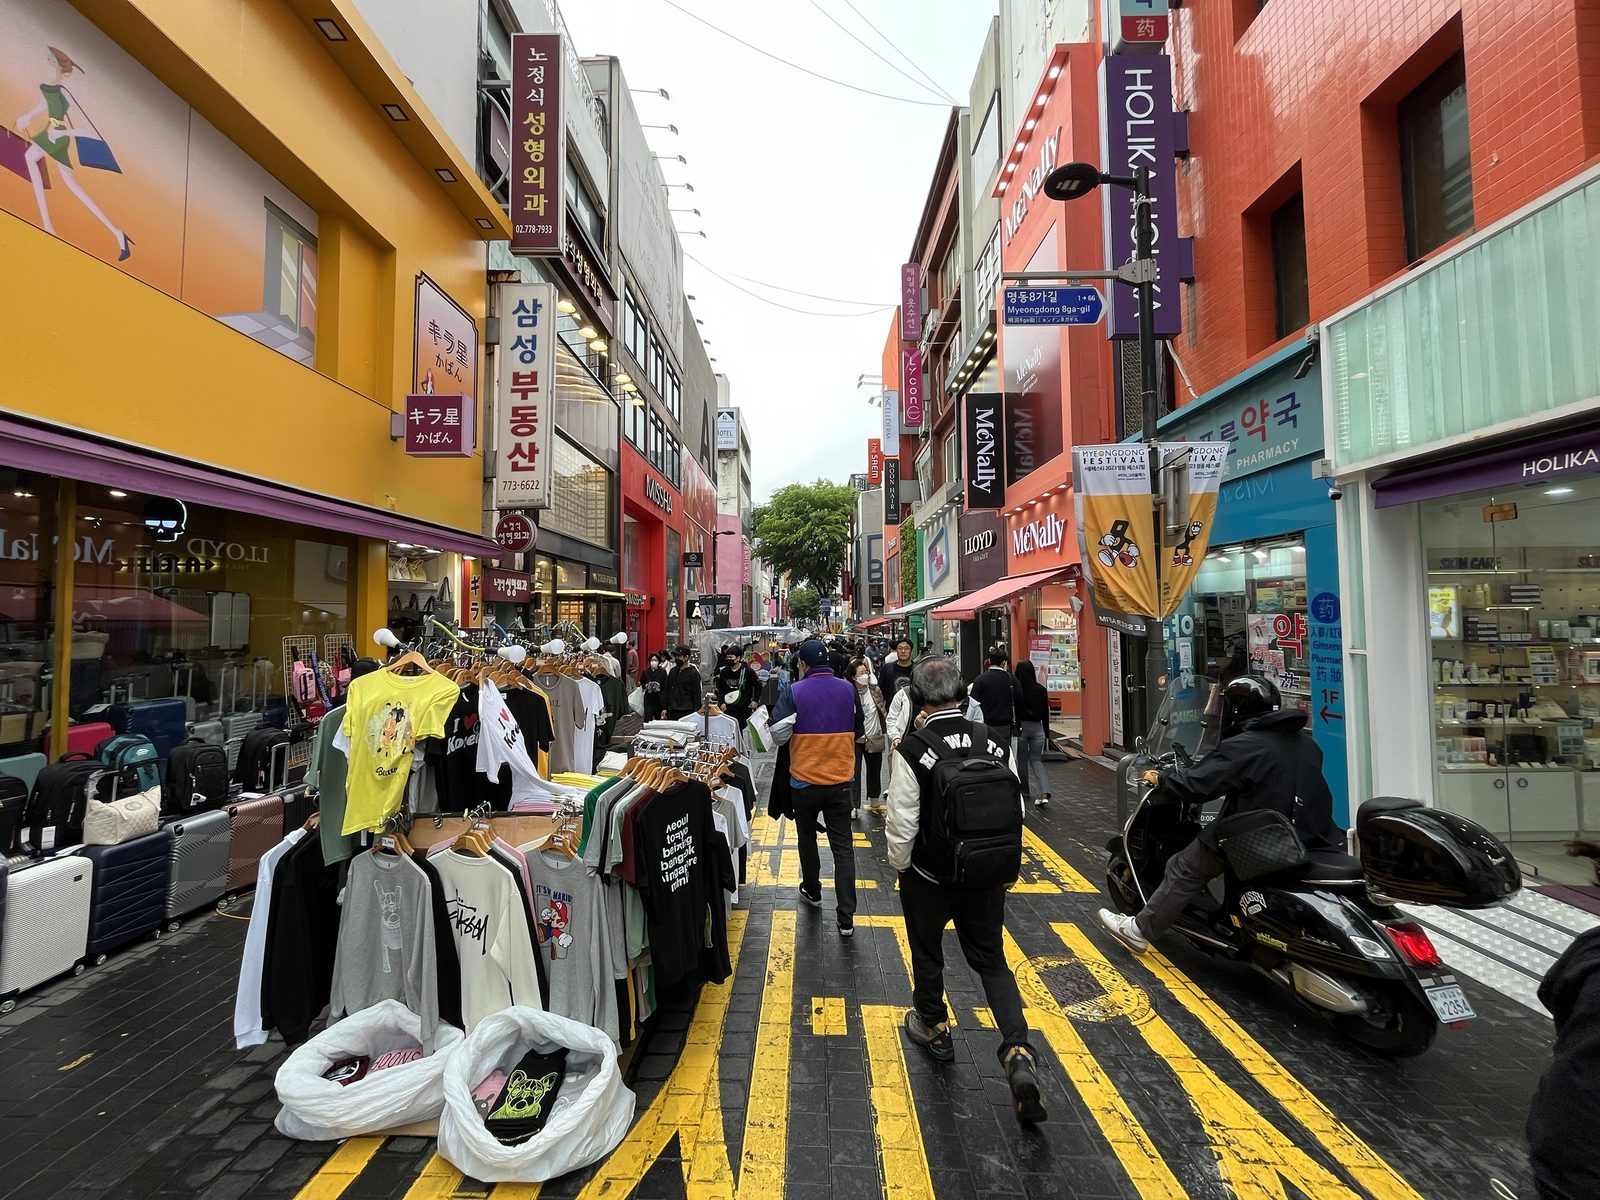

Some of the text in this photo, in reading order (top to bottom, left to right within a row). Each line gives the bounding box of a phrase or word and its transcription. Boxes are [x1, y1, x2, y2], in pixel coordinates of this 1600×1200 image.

[1136, 19, 1155, 37] 药
[522, 47, 549, 217] 노정식 성형외과
[515, 224, 553, 234] 02.778-7933
[1007, 291, 1058, 304] 명동8가길
[1007, 304, 1091, 315] Myeongdong 8ga-gil
[429, 318, 469, 369] キラ星
[435, 353, 463, 383] かばん
[409, 407, 461, 426] キラ星
[415, 432, 453, 444] かばん
[1082, 448, 1145, 457] MYEONGDONG
[1083, 456, 1145, 465] FESTIVAL
[1237, 437, 1300, 470] PHARMACY
[1522, 448, 1600, 477] HOLIKA
[502, 480, 540, 491] 773-6622
[646, 473, 673, 516] MISSHA
[964, 529, 994, 556] LLOYD
[1440, 556, 1468, 570] SKIN
[1272, 612, 1307, 660] 약
[1321, 688, 1340, 704] 1F
[1443, 998, 1471, 1016] 2354
